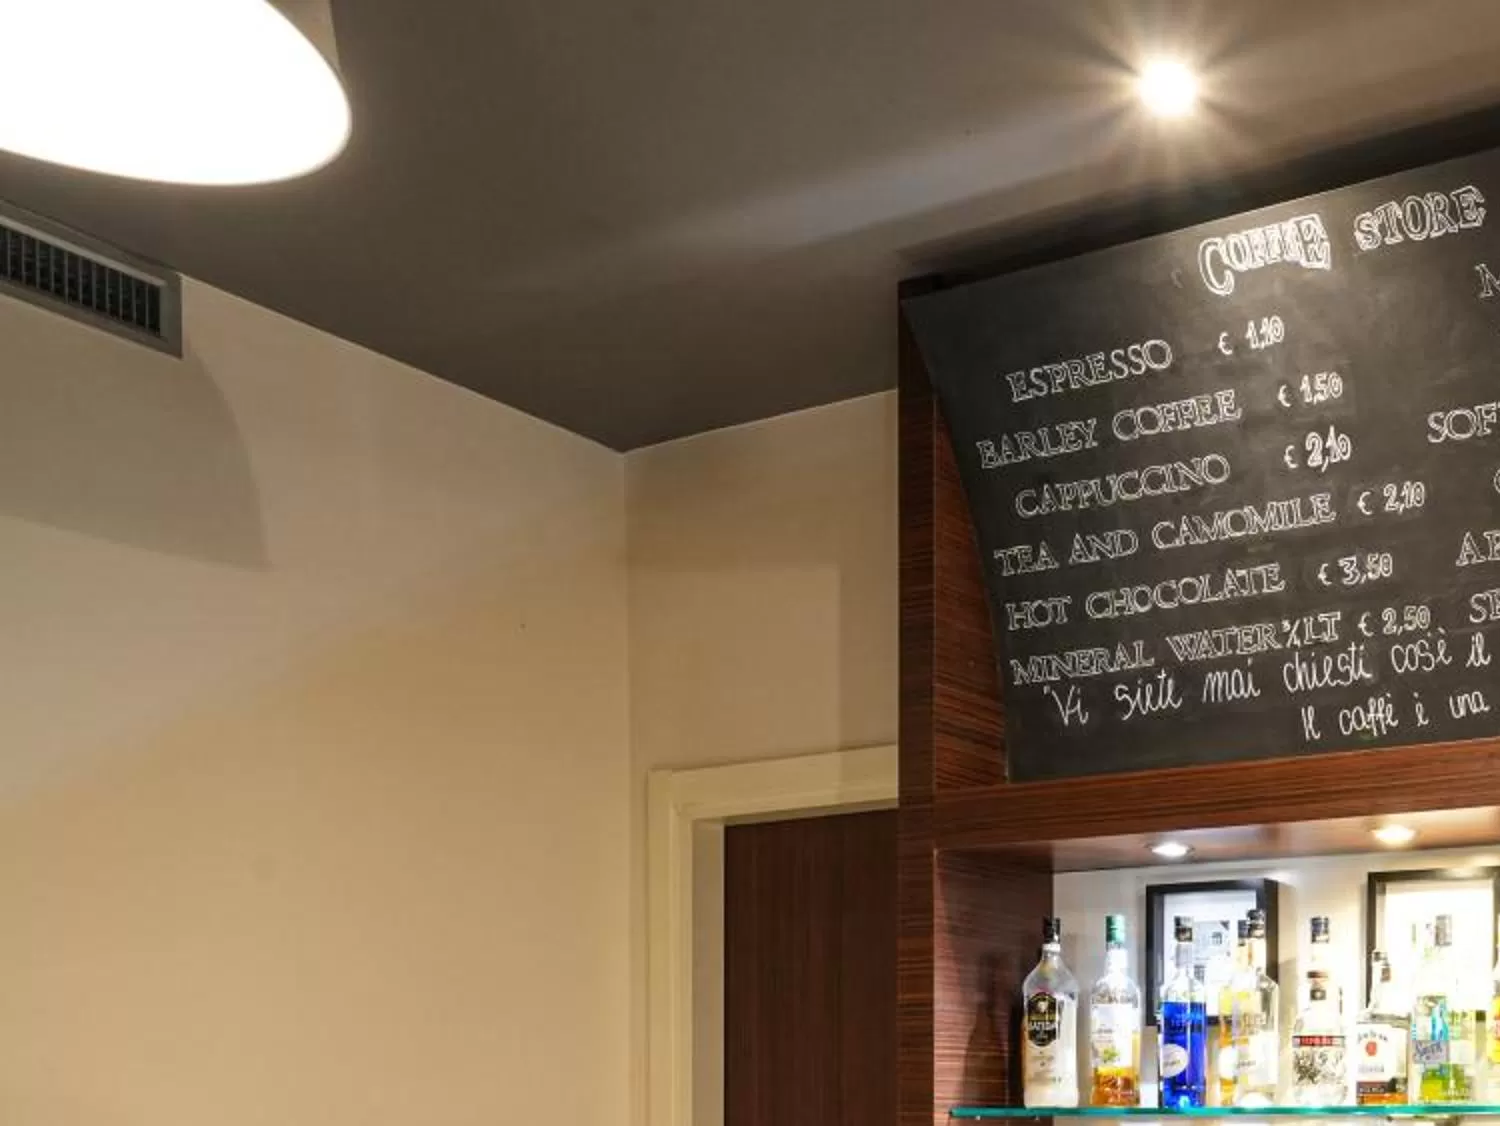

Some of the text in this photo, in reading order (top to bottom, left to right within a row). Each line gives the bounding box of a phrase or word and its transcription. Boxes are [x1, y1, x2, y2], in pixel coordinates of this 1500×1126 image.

[1353, 185, 1487, 252] STORE
[1005, 338, 1173, 403] ESPRESSO
[976, 418, 1099, 470] BARLEY
[1112, 388, 1243, 441] COFFEE
[1015, 452, 1231, 519] CAPPUCCINO
[993, 540, 1060, 576] TEA
[1069, 529, 1139, 566] AND
[1151, 492, 1337, 549] CAMOMILE
[1006, 595, 1072, 631] HOT
[1085, 562, 1286, 619] CHOCOLATE
[1011, 639, 1156, 685] MINERAL
[1165, 623, 1282, 663] WATER
[1202, 657, 1262, 704] mai
[1282, 640, 1373, 693] chiesti
[1448, 690, 1491, 720] una
